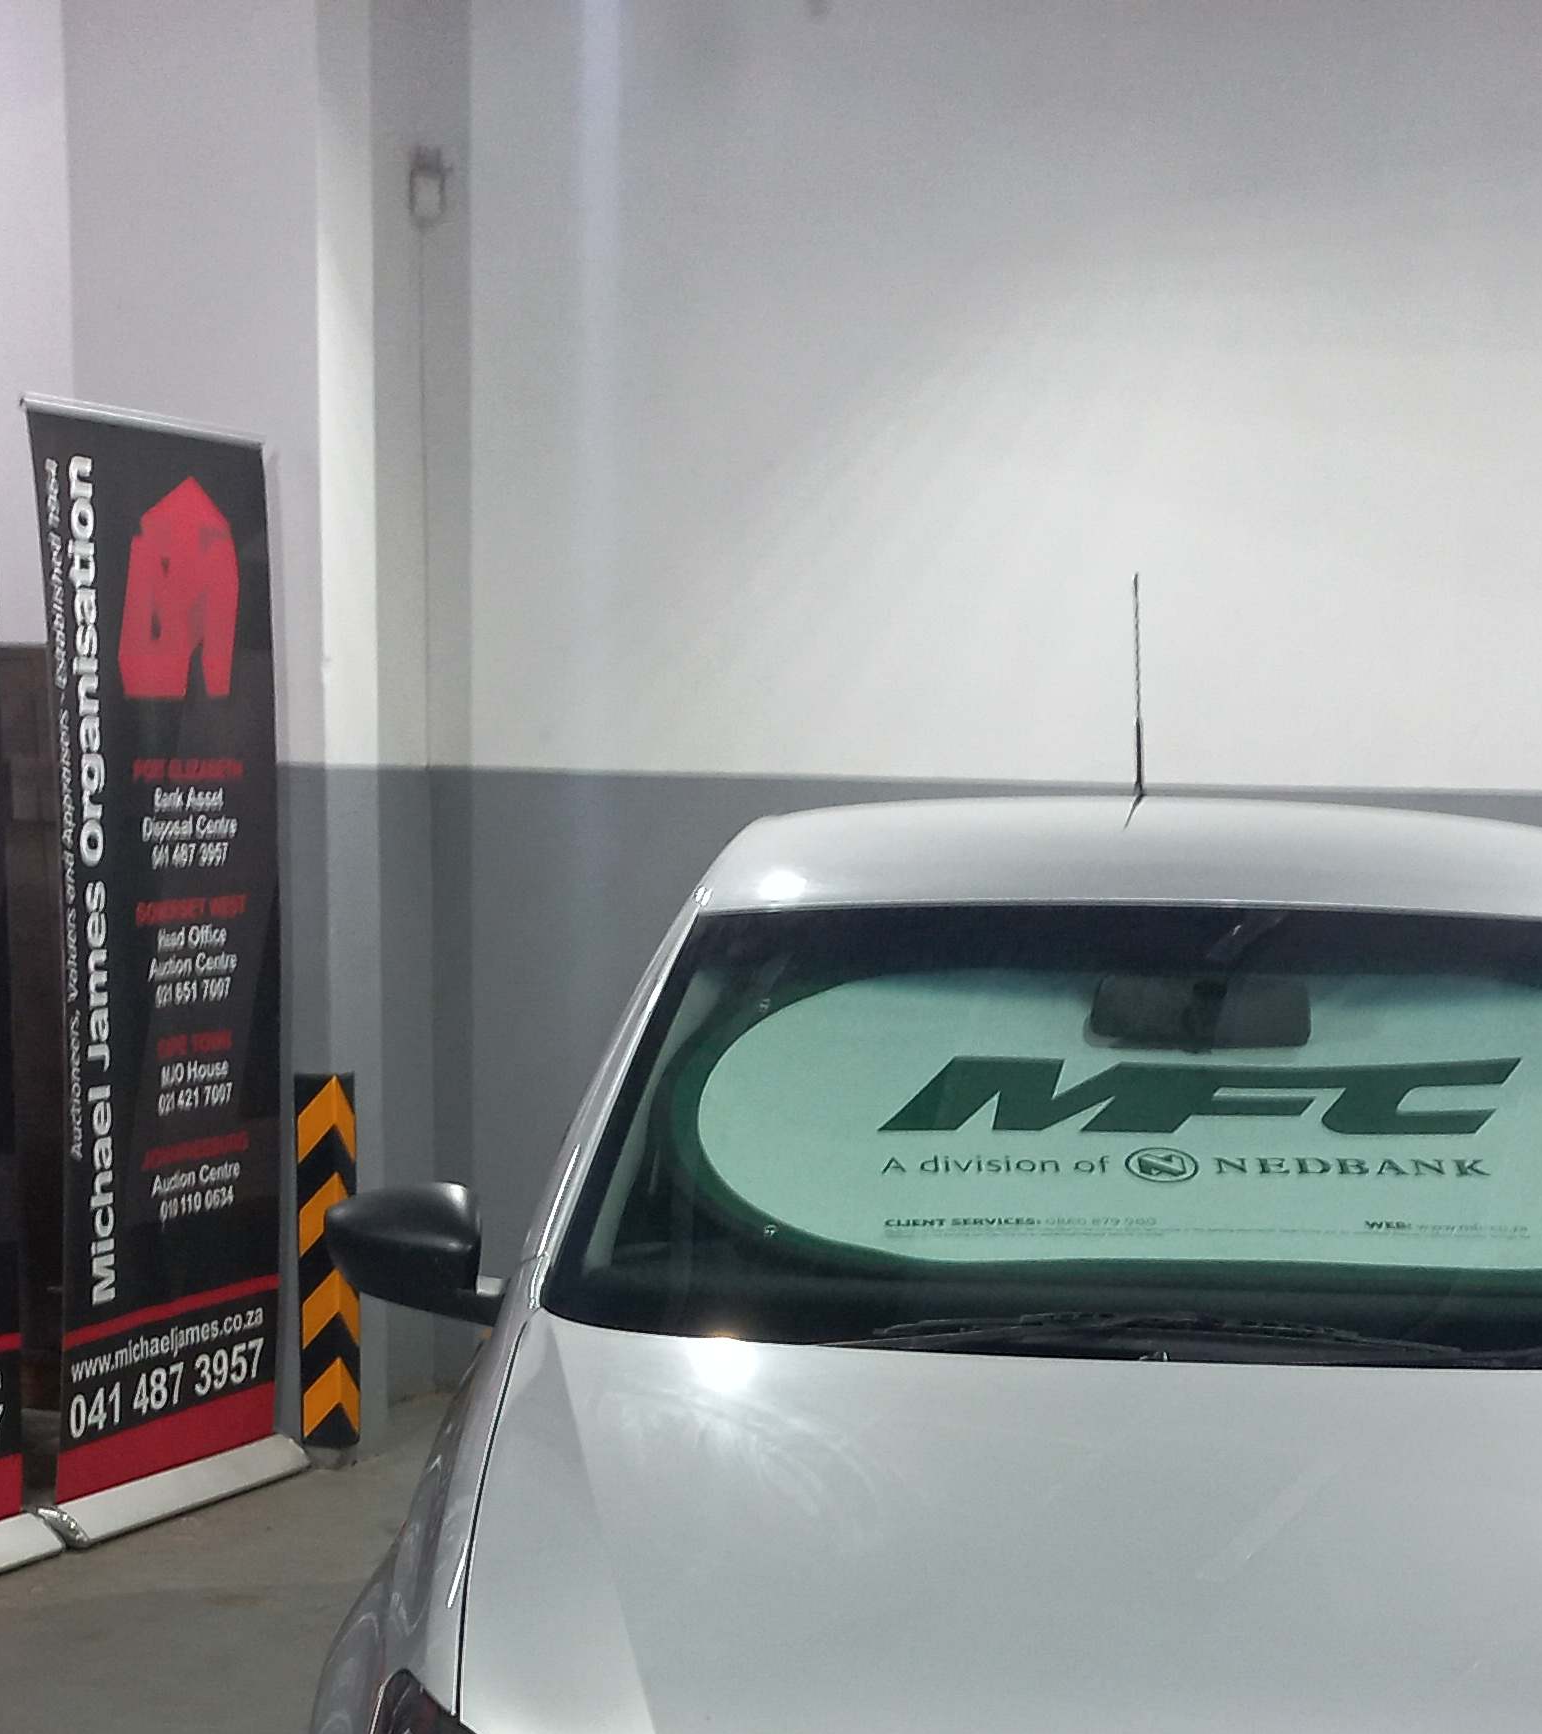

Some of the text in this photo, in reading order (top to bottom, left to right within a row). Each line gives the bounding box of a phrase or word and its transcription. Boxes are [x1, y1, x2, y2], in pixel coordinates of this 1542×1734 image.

[84, 880, 110, 1072] James
[876, 1054, 1521, 1136] MFC
[89, 1084, 115, 1307] Michael
[881, 1155, 1491, 1177] A division of NEDBANK
[884, 1218, 945, 1228] CLIENT
[71, 1306, 264, 1383] www.michaeljames.co.za
[69, 1338, 265, 1440] 041 487 3957
